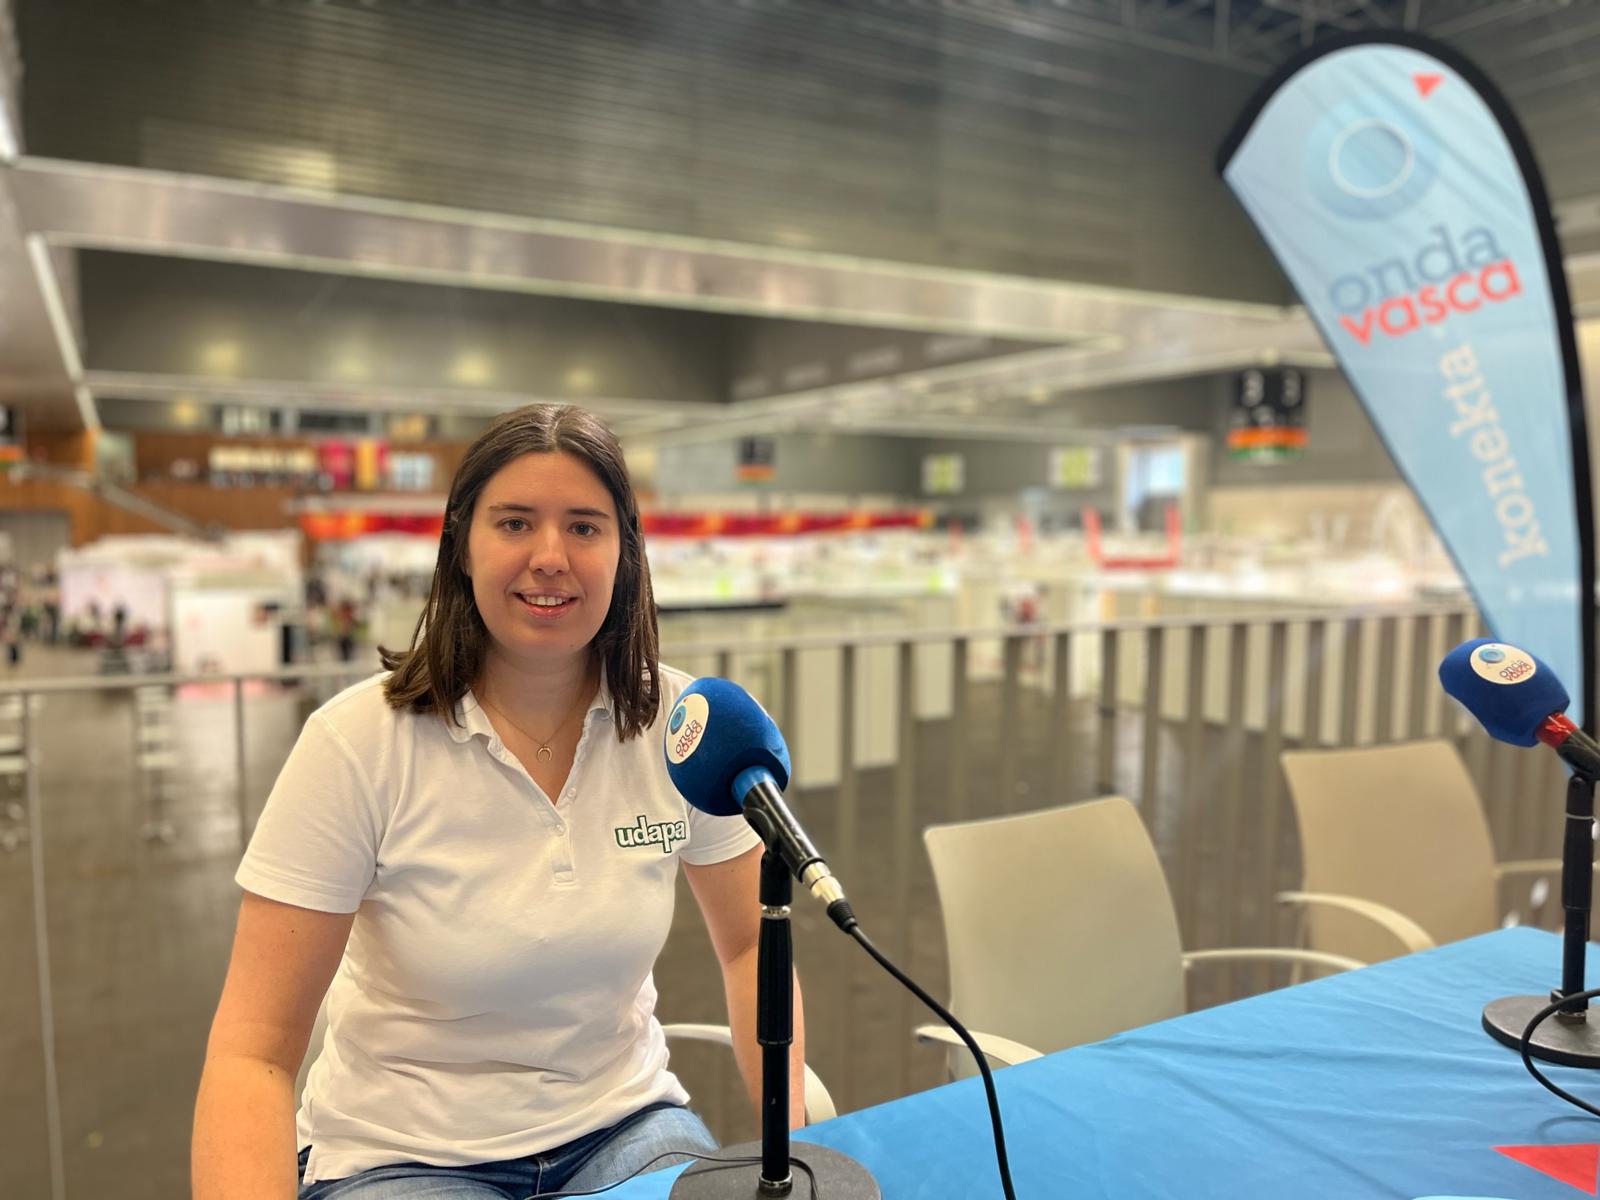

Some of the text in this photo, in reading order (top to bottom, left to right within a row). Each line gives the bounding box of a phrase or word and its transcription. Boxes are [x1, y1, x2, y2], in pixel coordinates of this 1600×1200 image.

[1330, 223, 1509, 313] onda
[1339, 257, 1521, 345] vasca
[1440, 343, 1547, 566] konekta
[675, 719, 698, 754] onda
[678, 721, 703, 758] vasca
[616, 815, 686, 854] udapa
